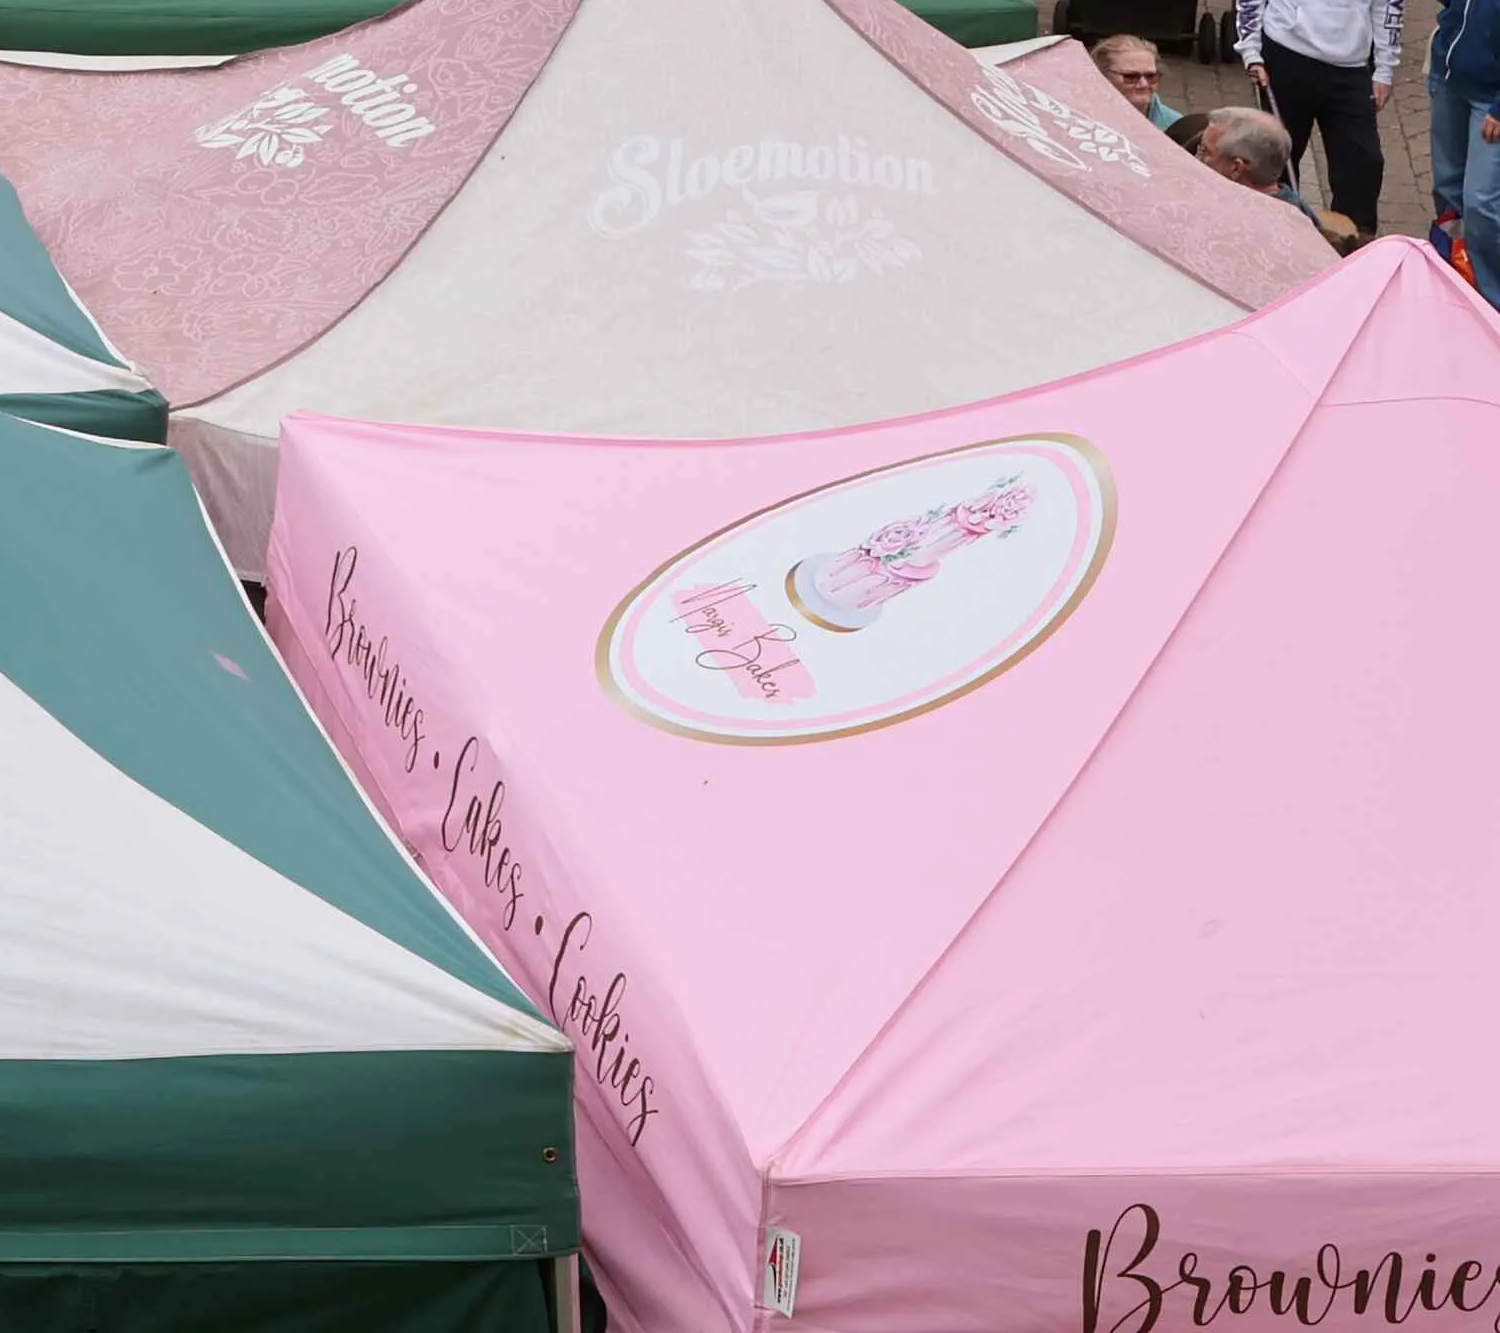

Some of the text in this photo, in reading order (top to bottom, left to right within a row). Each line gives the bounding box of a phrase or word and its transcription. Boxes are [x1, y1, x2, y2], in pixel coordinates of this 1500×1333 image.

[589, 133, 938, 238] Sloemotion
[696, 623, 800, 698] Bakes
[326, 545, 659, 1146] Brownies Cakes Cookies
[1082, 1203, 1500, 1333] Brownie
